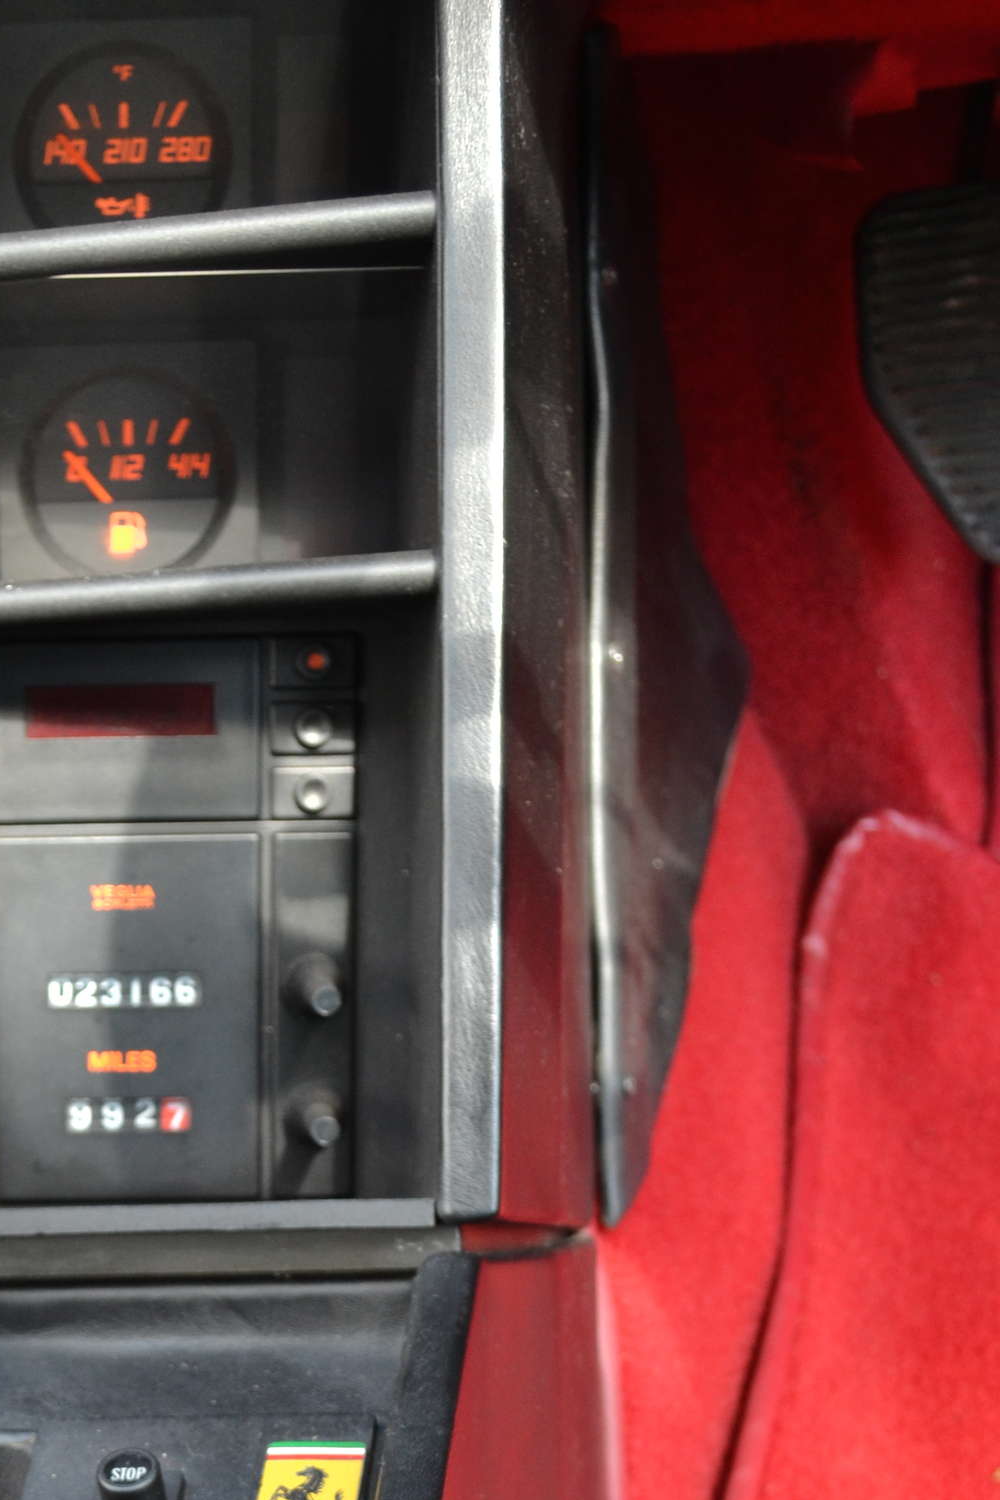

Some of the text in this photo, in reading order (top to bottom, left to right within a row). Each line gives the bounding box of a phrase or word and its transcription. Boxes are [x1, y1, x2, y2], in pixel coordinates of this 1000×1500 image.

[103, 137, 148, 165] 210
[158, 135, 212, 163] 280
[87, 1050, 157, 1073] MILES
[111, 1466, 147, 1481] STOP
